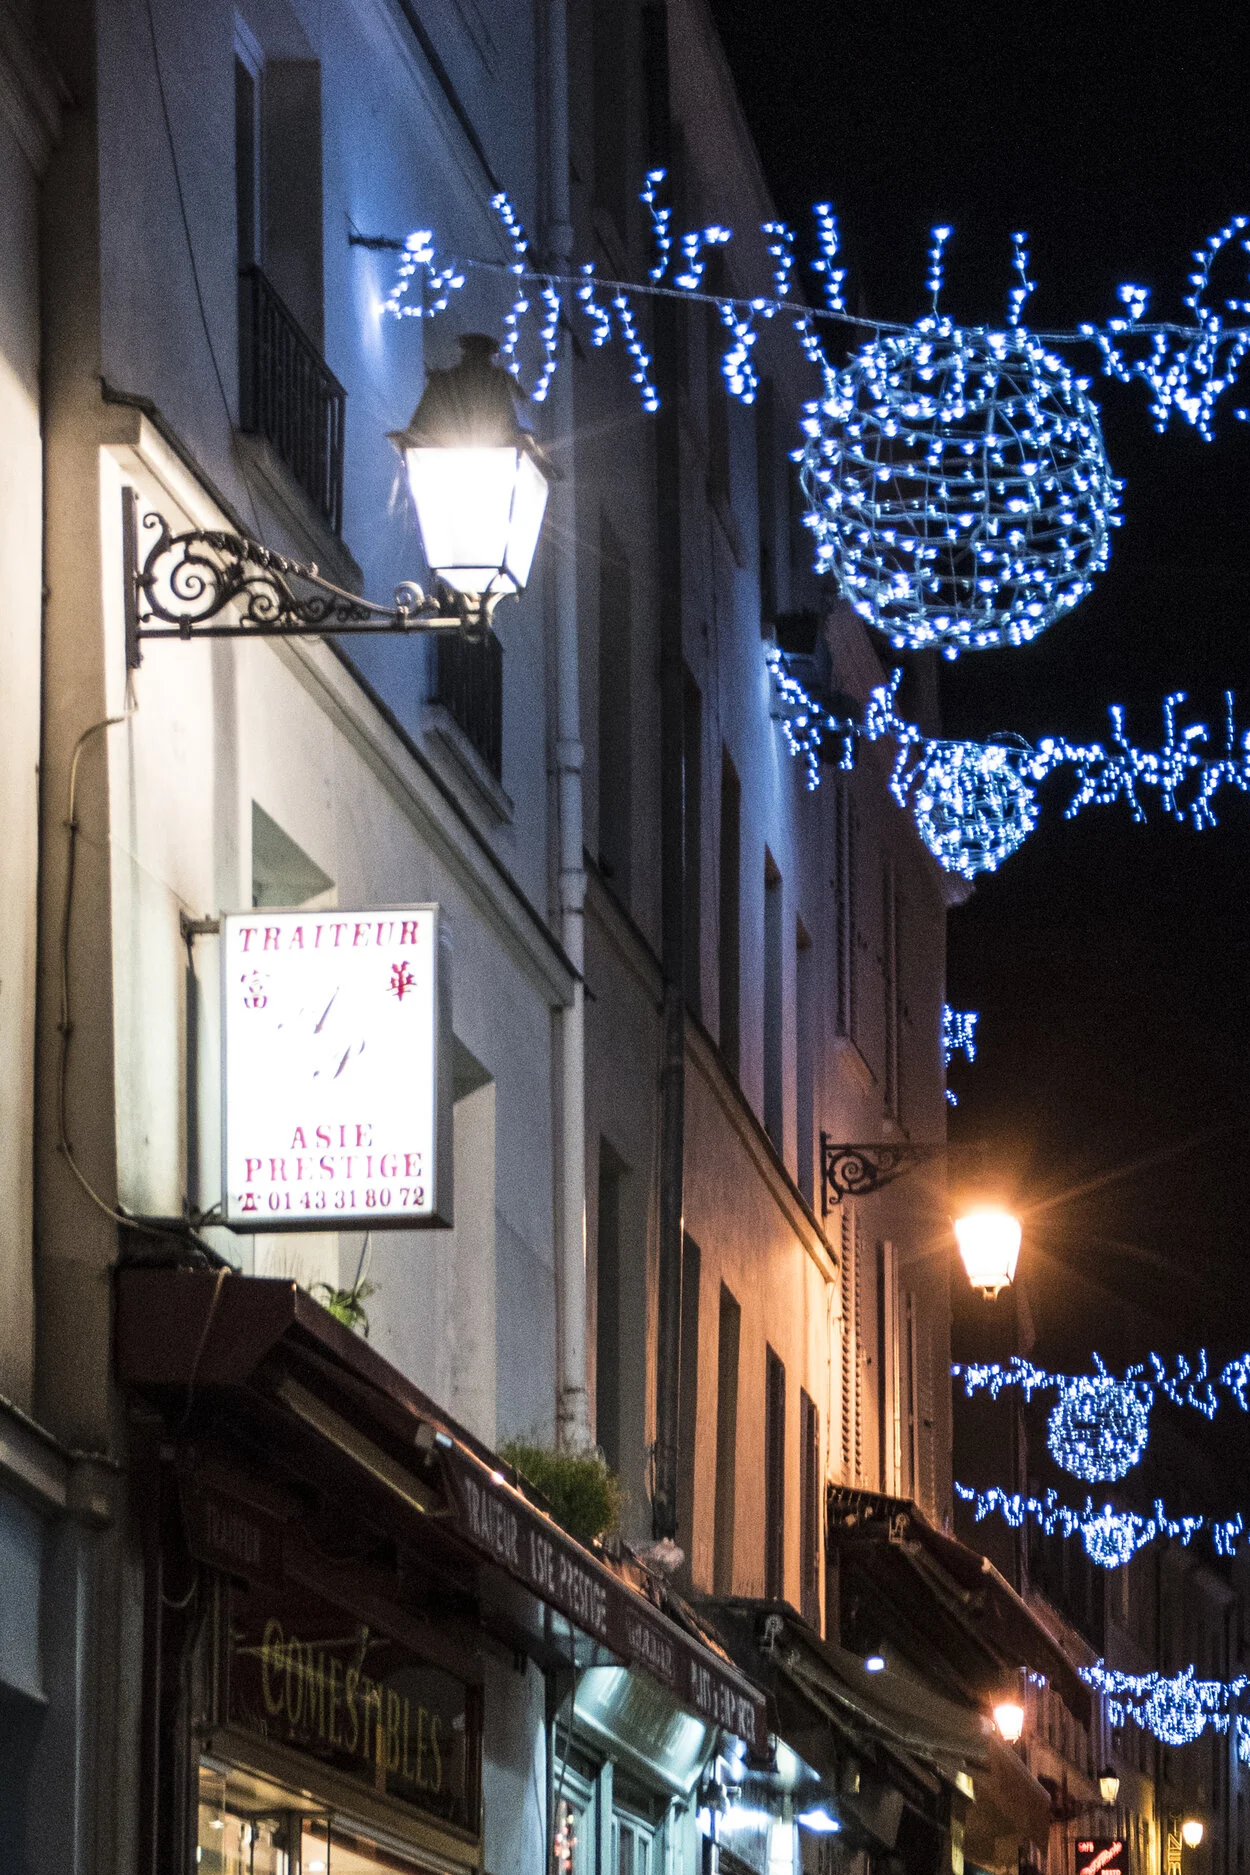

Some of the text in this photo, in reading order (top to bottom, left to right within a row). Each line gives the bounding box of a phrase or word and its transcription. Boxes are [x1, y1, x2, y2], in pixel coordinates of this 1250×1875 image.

[238, 920, 420, 952] TRAITEUR
[290, 1123, 373, 1150] ASIE
[244, 1152, 422, 1183] PRESTIGE
[268, 1185, 426, 1211] 01 43 31 80 72
[262, 1619, 442, 1791] COMESTIBLES
